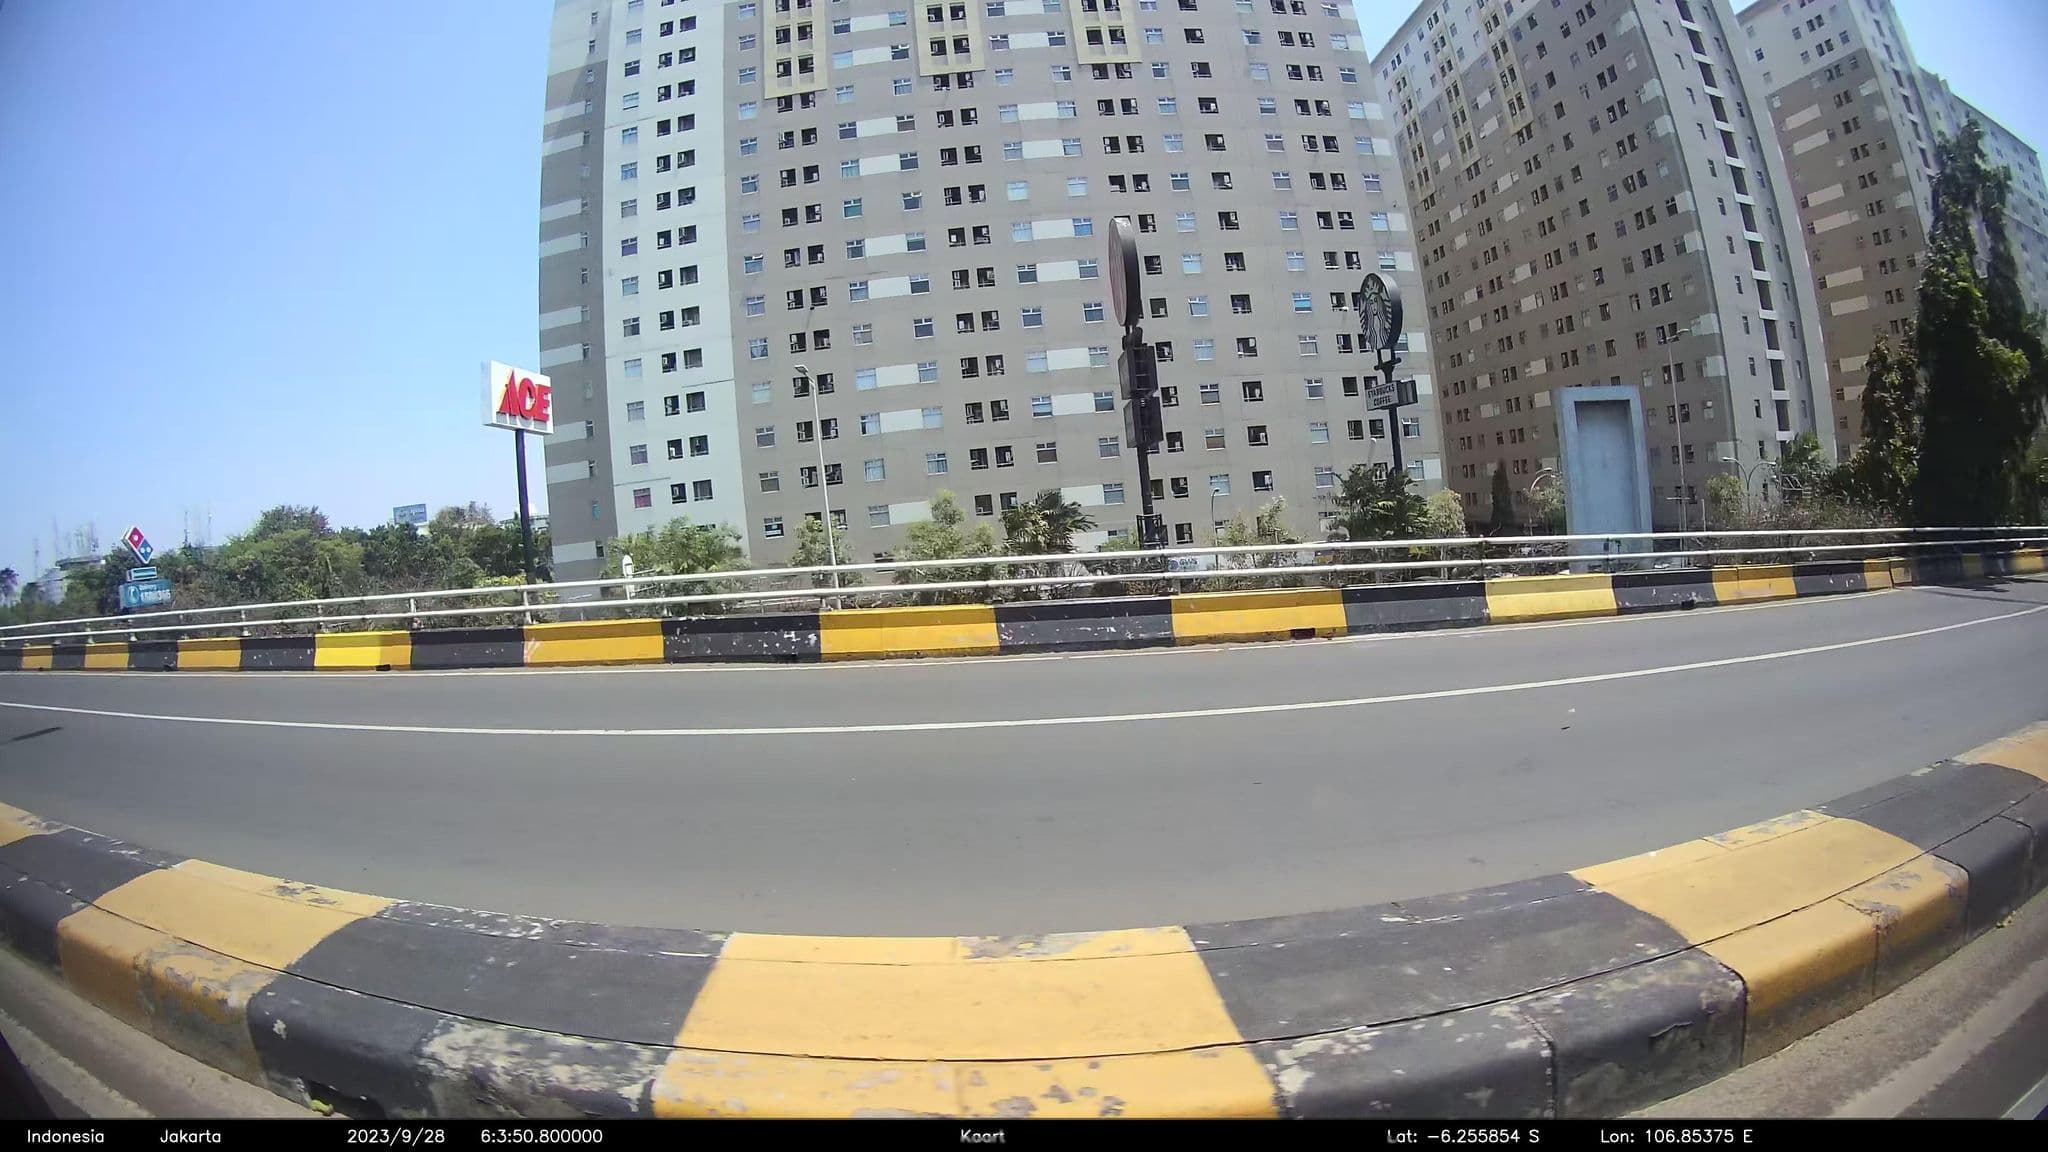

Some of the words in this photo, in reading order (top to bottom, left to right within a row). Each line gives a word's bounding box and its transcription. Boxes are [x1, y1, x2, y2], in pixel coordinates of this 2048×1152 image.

[499, 368, 552, 422] ACE
[1368, 383, 1394, 398] STARBUCKS
[1374, 395, 1392, 406] COFFEE
